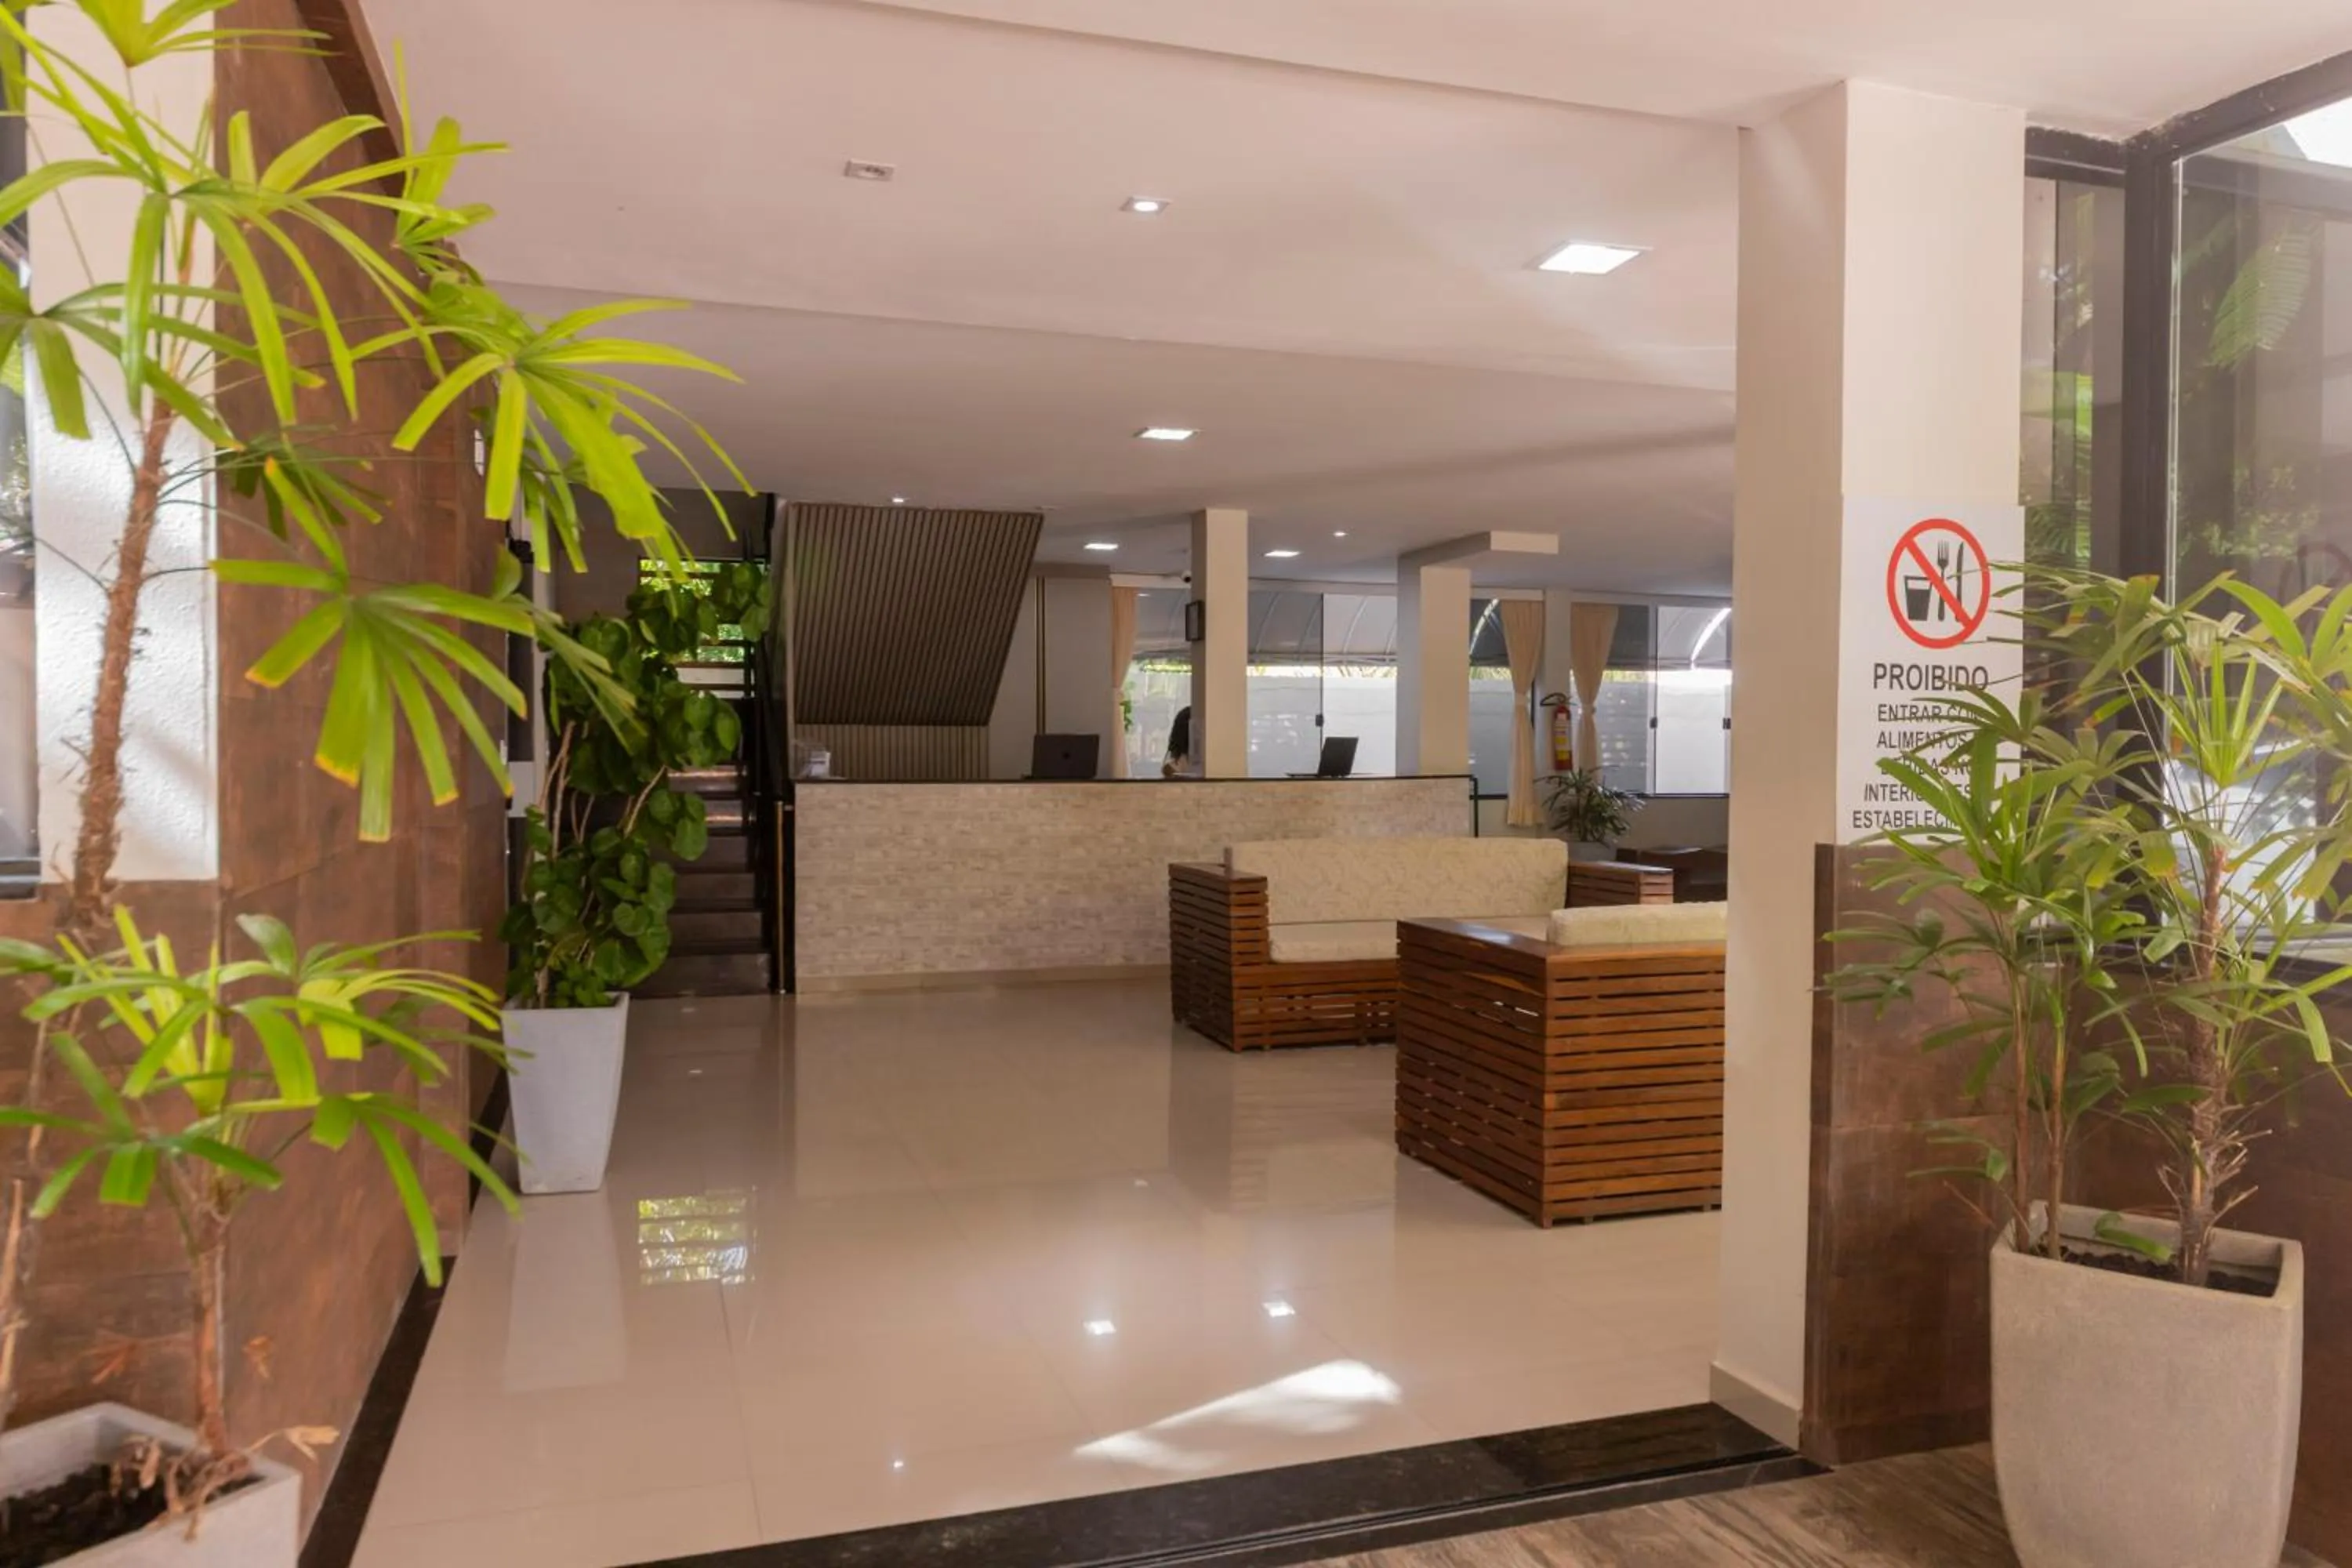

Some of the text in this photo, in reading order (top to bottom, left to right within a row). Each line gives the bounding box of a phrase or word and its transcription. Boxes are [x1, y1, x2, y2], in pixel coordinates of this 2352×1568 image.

[1873, 662, 1987, 691] PROIBIDO
[1878, 703, 1942, 722] ENTRAR
[1864, 783, 1924, 802] INTERI
[1853, 810, 1958, 829] ESTABELECI
